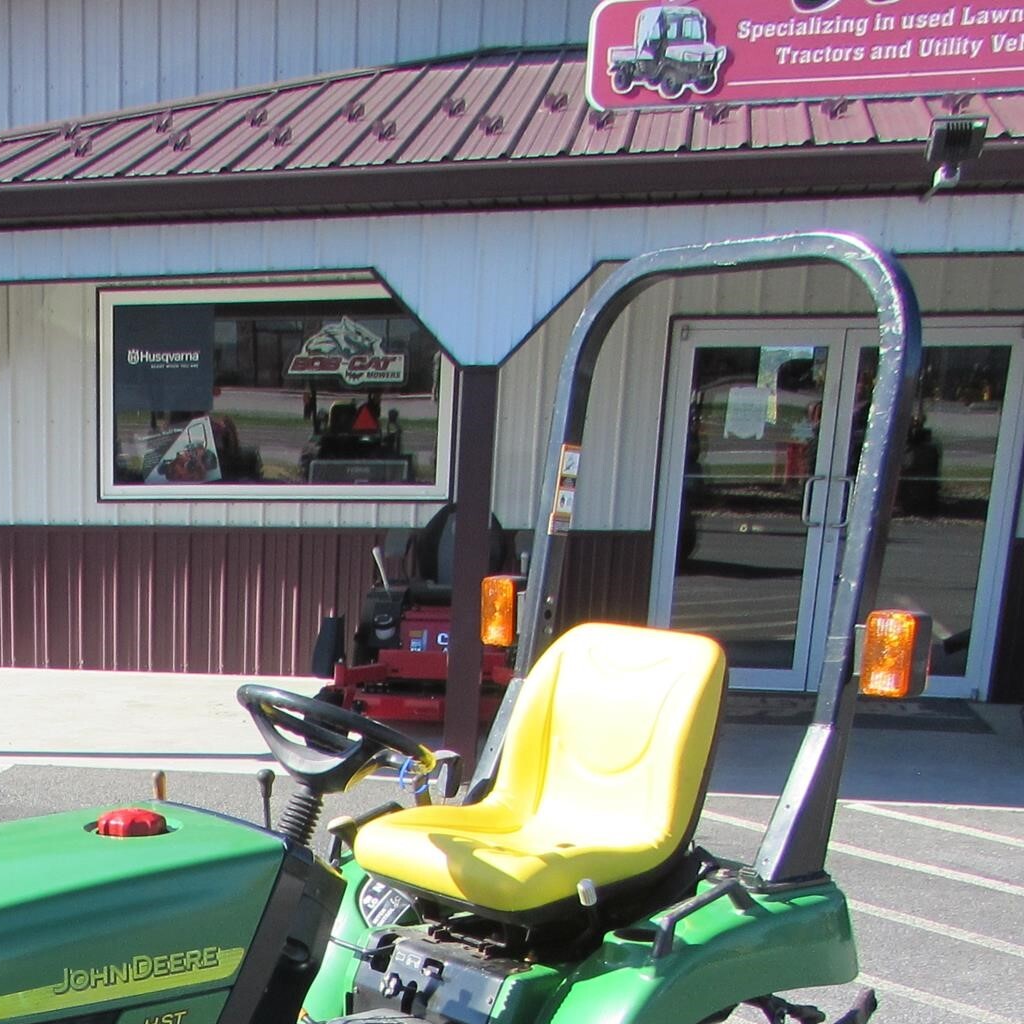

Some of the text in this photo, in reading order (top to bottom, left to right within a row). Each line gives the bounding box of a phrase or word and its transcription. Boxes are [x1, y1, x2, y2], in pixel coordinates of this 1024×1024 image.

[737, 6, 1024, 42] Specializing in used Lawn
[776, 46, 864, 65] Tractors
[870, 41, 912, 59] and
[919, 36, 984, 59] Utility
[140, 350, 199, 364] Husqvarna
[290, 356, 397, 371] BOB-CAT
